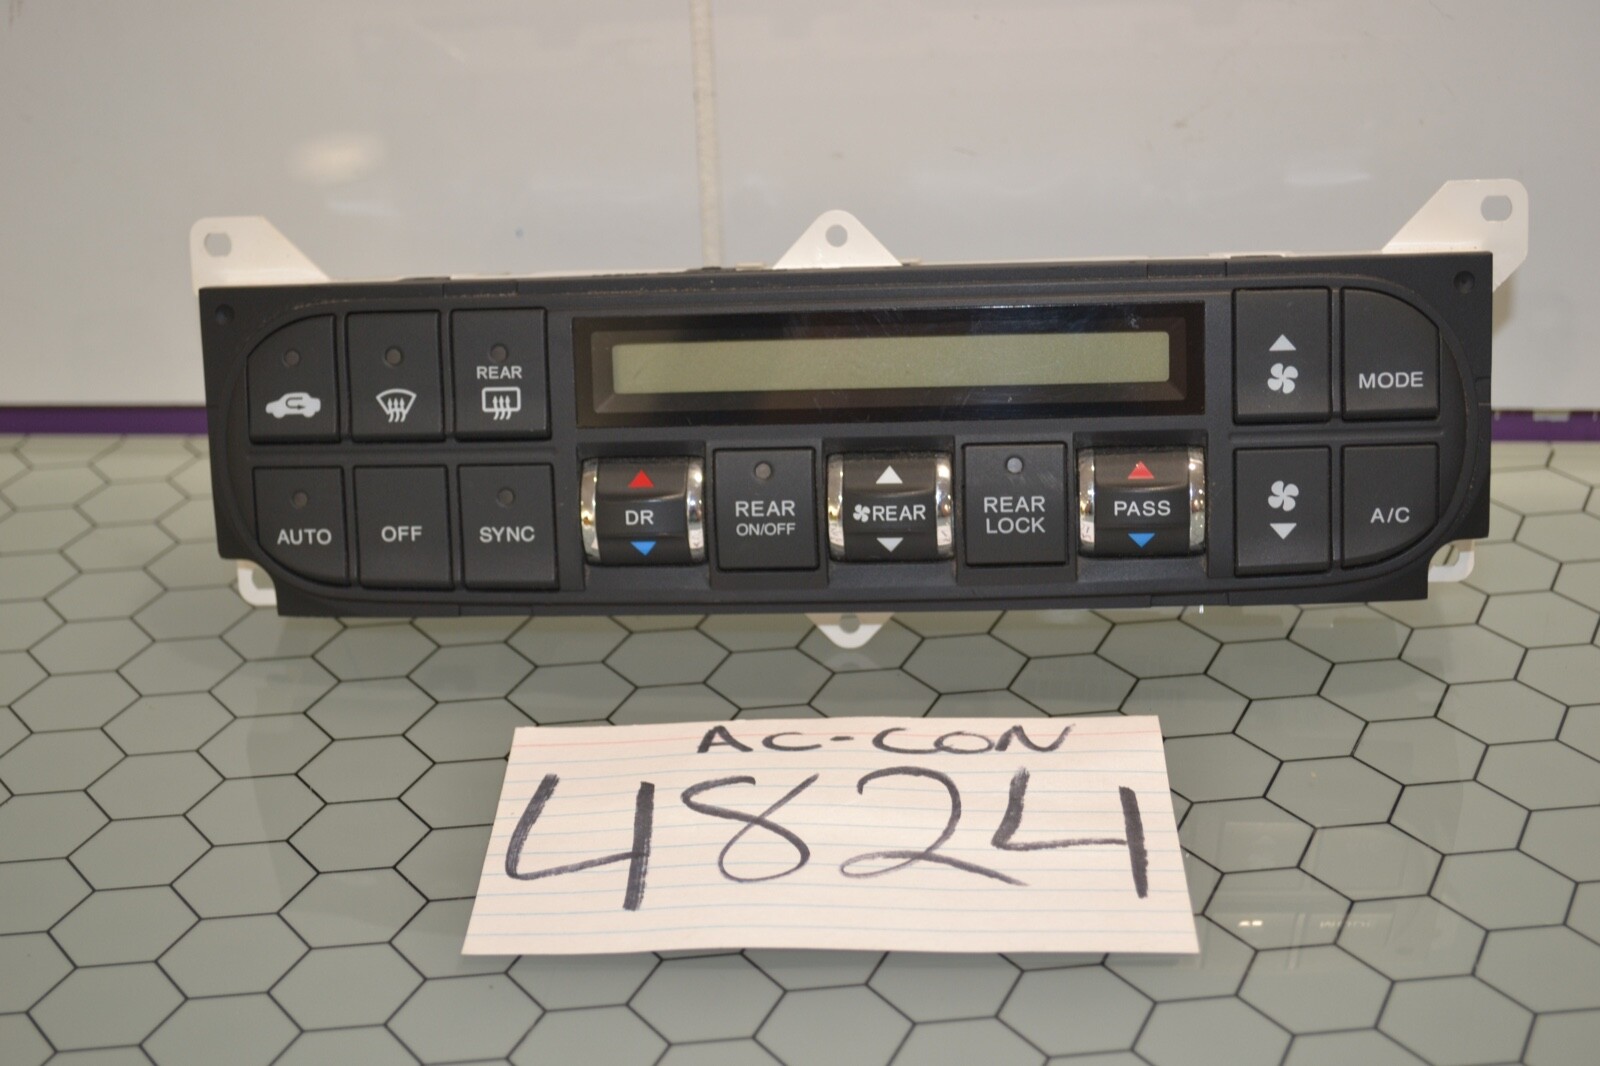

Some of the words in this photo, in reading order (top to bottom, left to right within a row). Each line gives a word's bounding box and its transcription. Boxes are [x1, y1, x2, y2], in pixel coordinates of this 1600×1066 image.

[476, 365, 523, 380] REAR
[1358, 371, 1424, 390] MODE
[735, 499, 796, 518] REAR
[872, 504, 926, 522] REAR
[983, 495, 1046, 514] REAR
[1113, 499, 1171, 517] PASS
[625, 509, 655, 526] DR
[1370, 506, 1410, 524] A/C
[380, 525, 423, 543] OFF
[479, 525, 536, 543] SYNC
[735, 521, 796, 538] ON/OFF
[985, 516, 1046, 535] LOCK
[276, 528, 333, 546] AUTO
[698, 723, 1075, 753] AC-CON
[505, 765, 1148, 911] 4824
